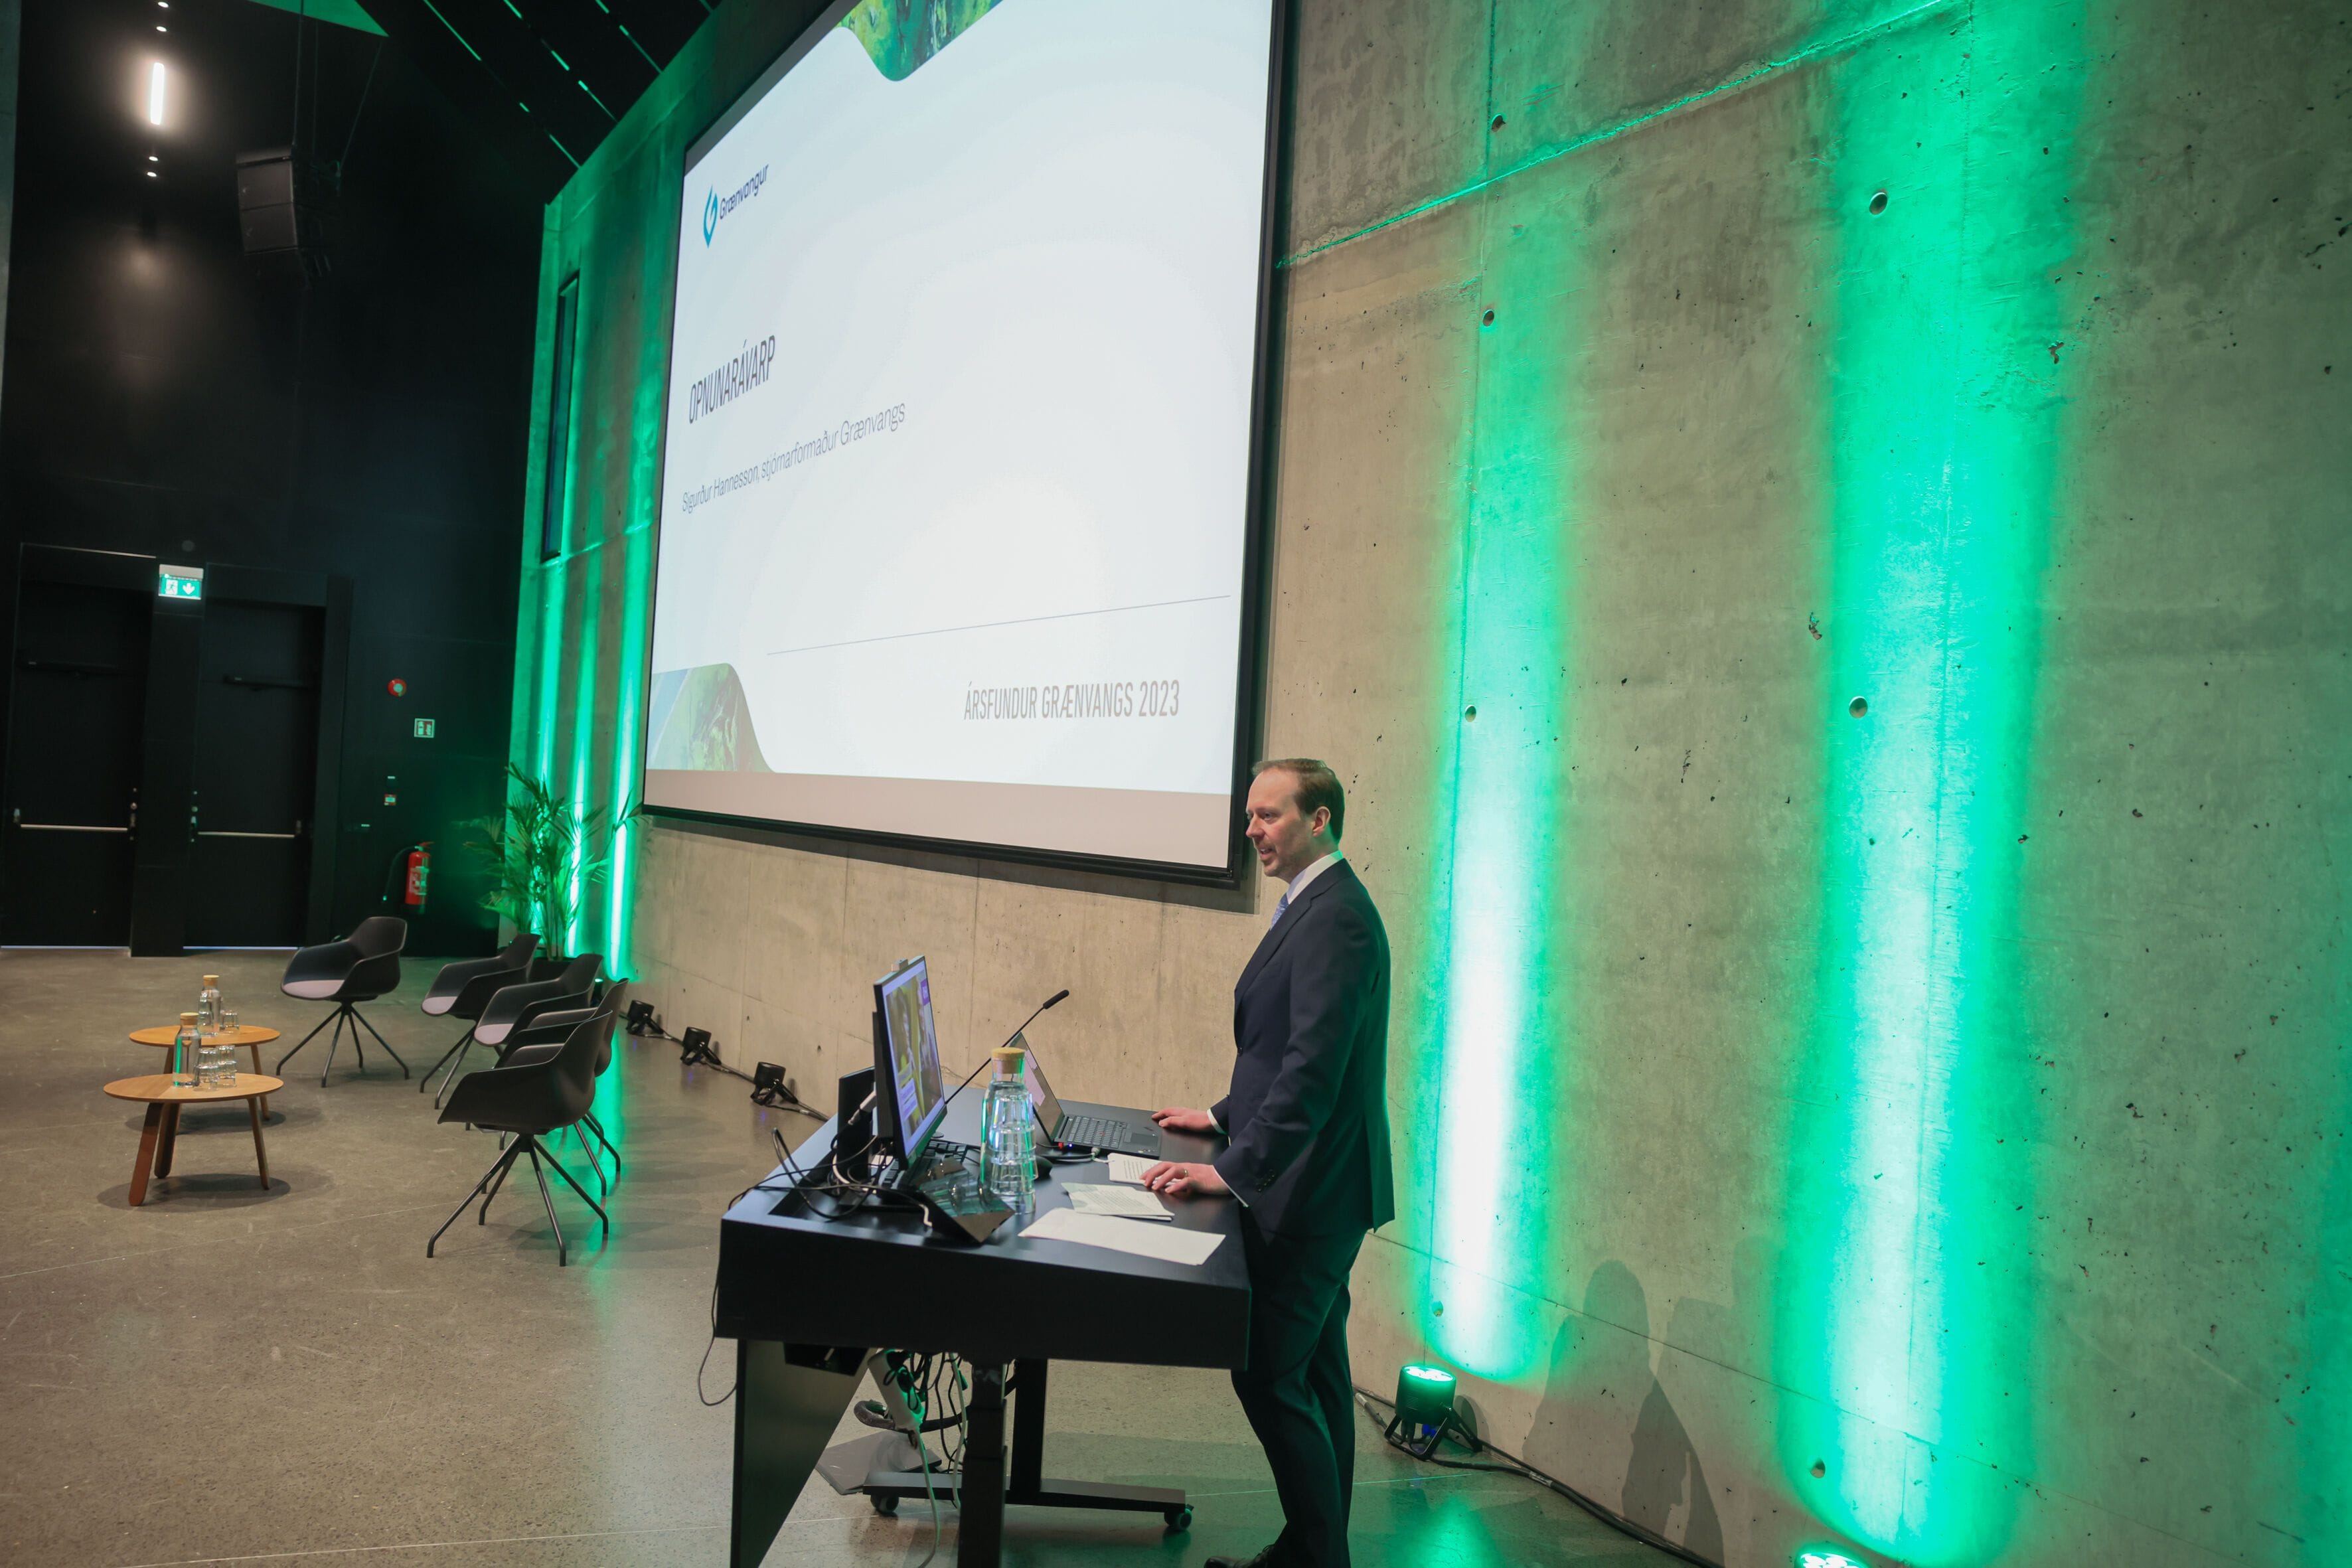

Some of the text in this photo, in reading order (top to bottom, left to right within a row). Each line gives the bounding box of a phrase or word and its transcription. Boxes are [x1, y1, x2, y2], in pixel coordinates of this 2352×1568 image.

[720, 164, 769, 220] Grænvangur
[689, 335, 775, 424] OPNUNARÁVARP
[682, 403, 905, 514] Sigurður Hannesson, stjórnarformaður Grænvangs
[964, 679, 1180, 720] ÁRSFUNDUR GRÆNVANGS 2023
